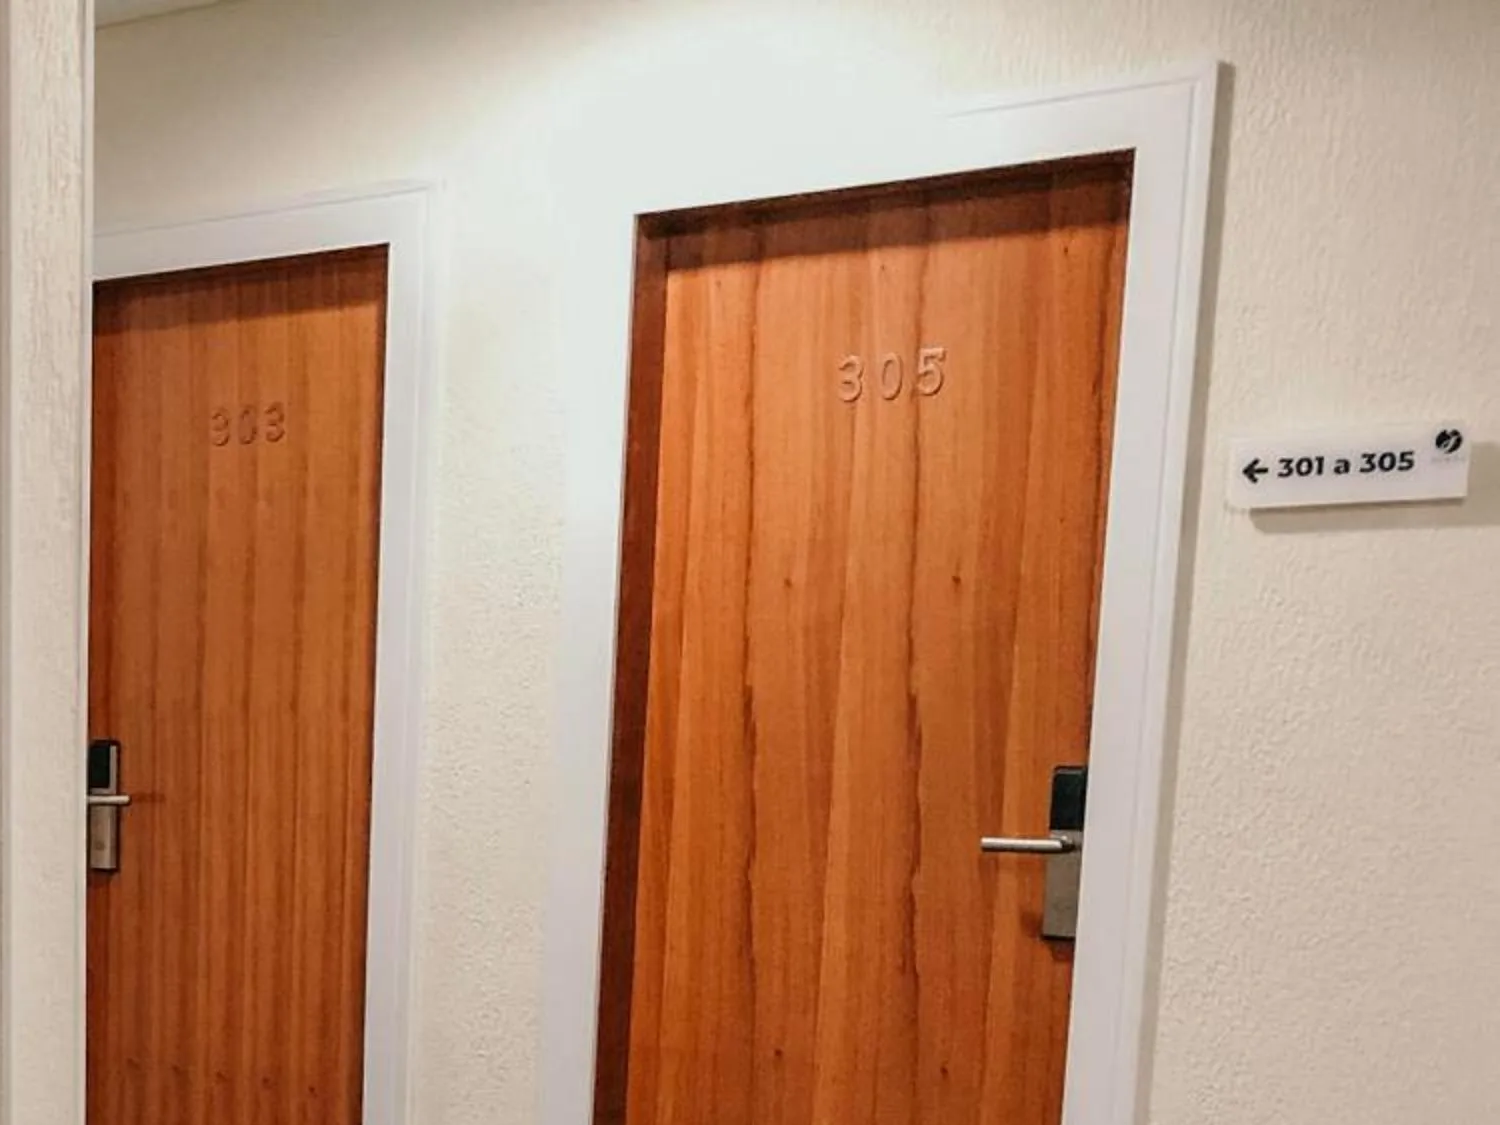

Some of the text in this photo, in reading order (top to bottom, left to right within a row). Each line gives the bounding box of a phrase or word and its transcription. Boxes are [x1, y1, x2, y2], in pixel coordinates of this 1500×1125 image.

[837, 347, 947, 403] 305
[210, 401, 286, 447] 303
[1277, 450, 1415, 478] 301 a 305
